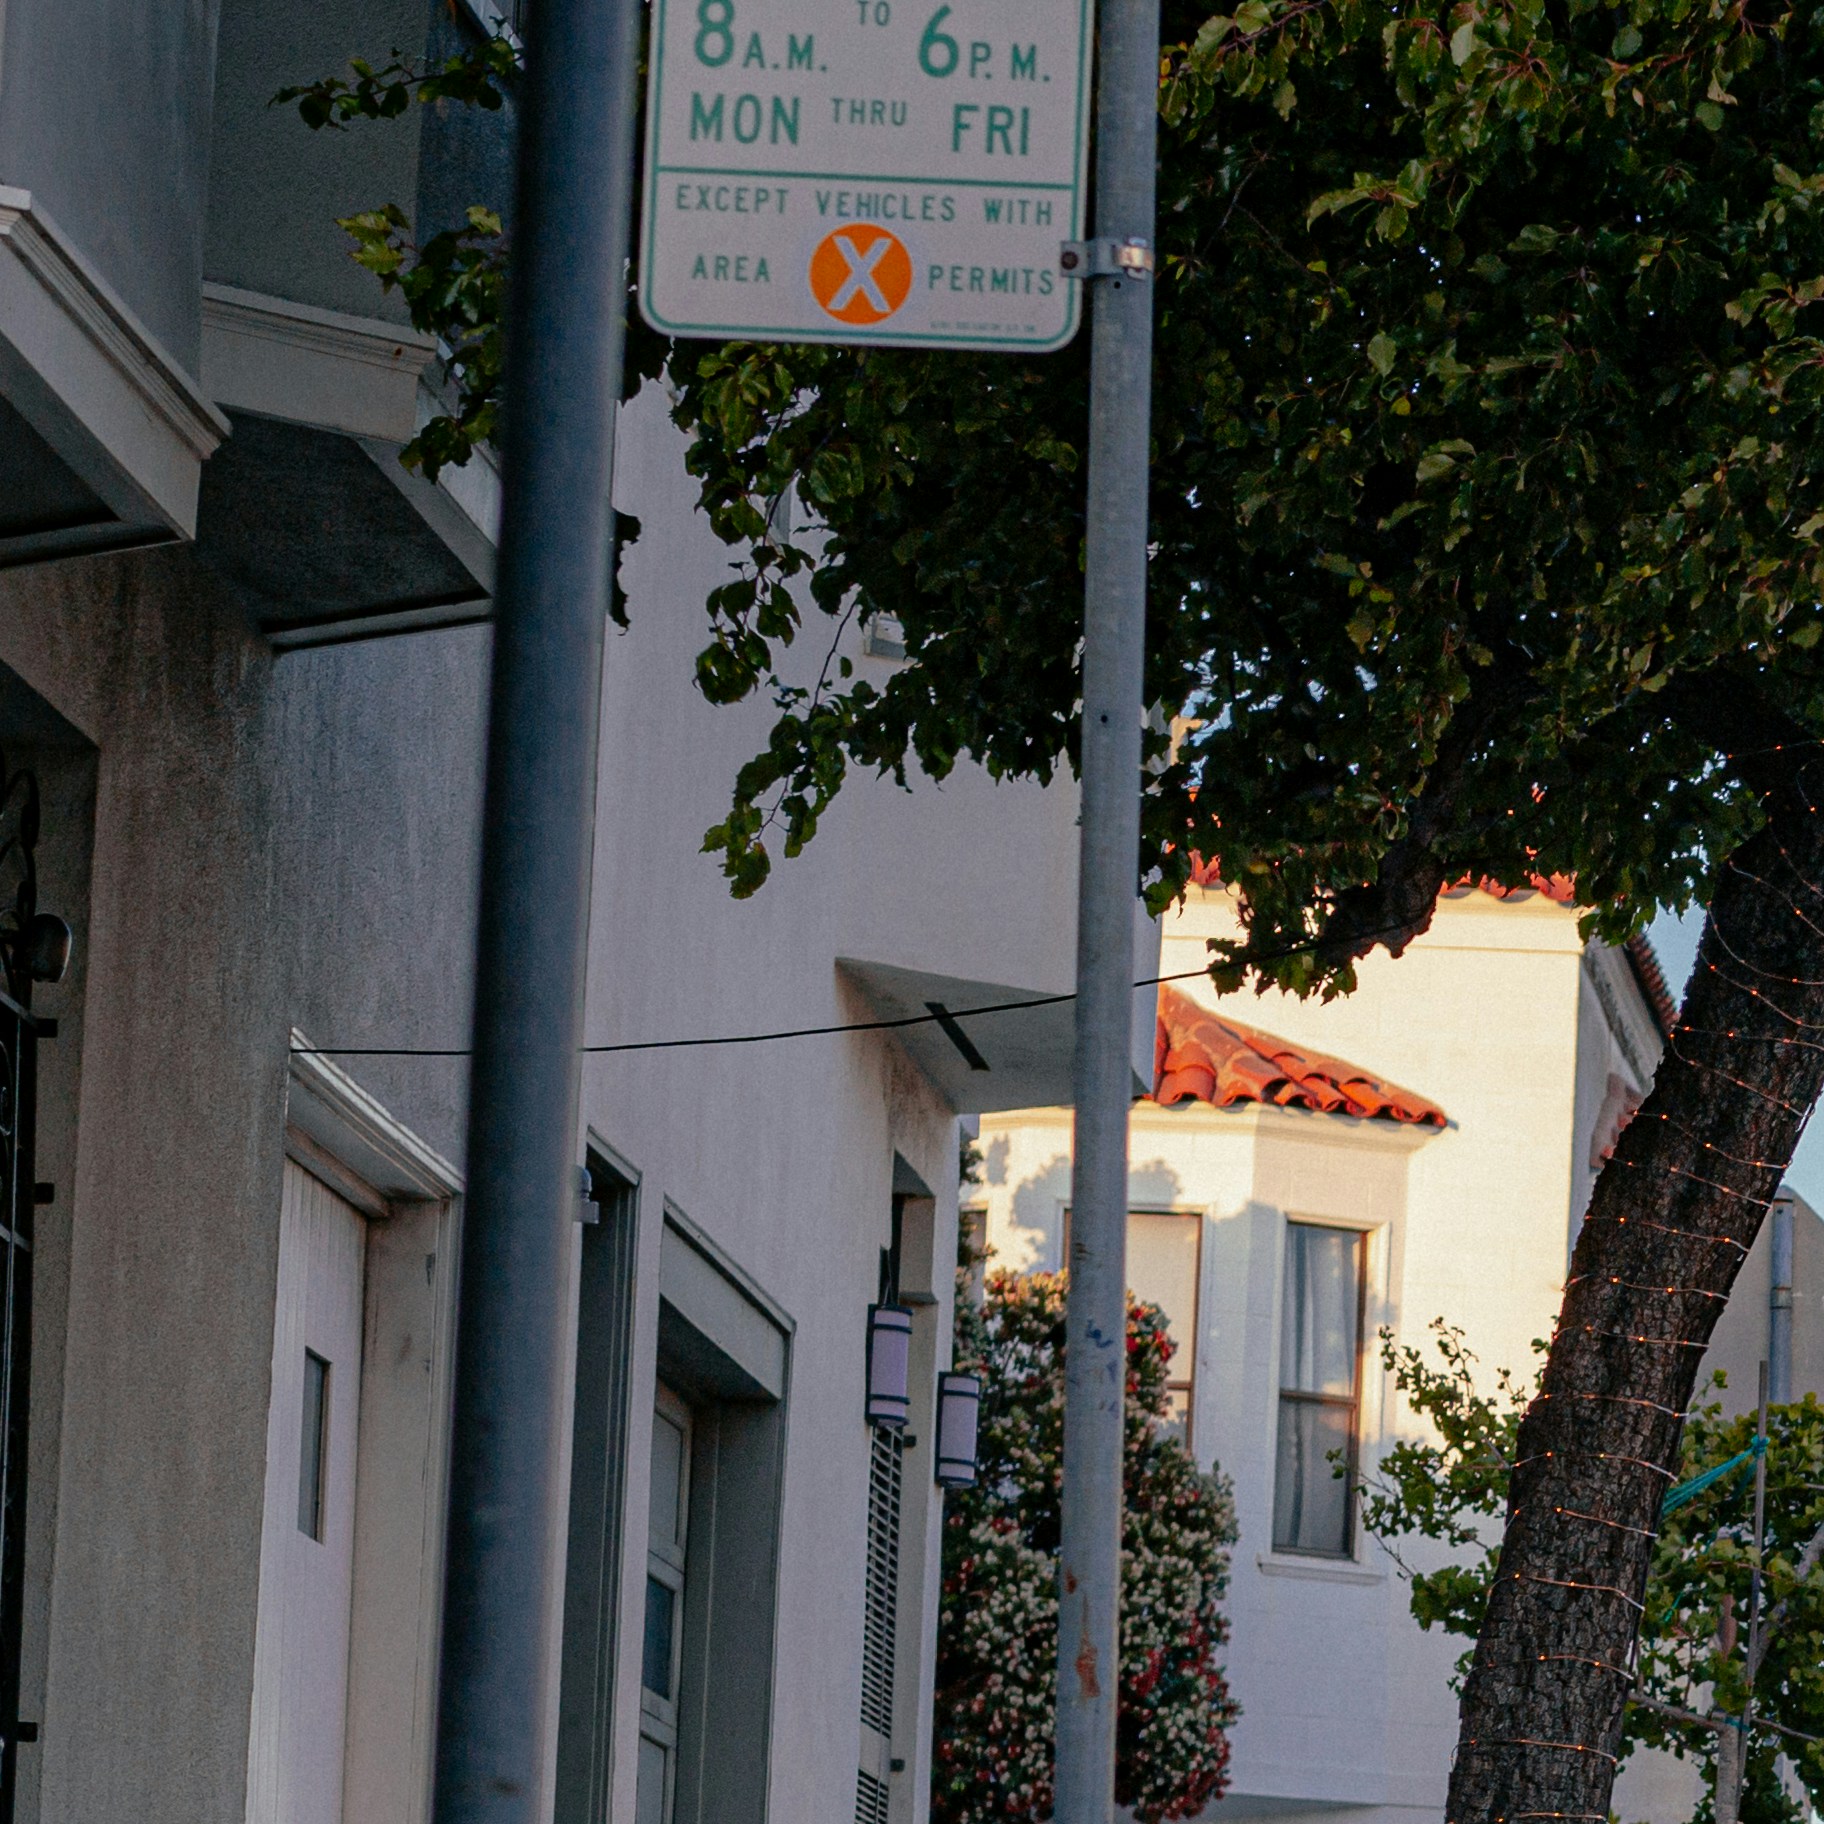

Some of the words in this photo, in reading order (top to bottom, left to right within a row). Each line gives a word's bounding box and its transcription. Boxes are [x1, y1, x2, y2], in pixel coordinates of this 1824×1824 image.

[694, 0, 734, 67] 8
[742, 31, 828, 72] A.M.
[857, 0, 890, 27] TO
[918, 4, 960, 79] 6
[689, 91, 800, 145] MON
[831, 97, 907, 127] THRU
[952, 103, 1030, 156] FRI
[675, 184, 789, 214] EXCEPT
[815, 189, 955, 222] VEHICLES
[984, 198, 1052, 226] WITH
[691, 253, 770, 283] AREA
[828, 235, 893, 314] X
[928, 265, 1053, 296] PERMITS
